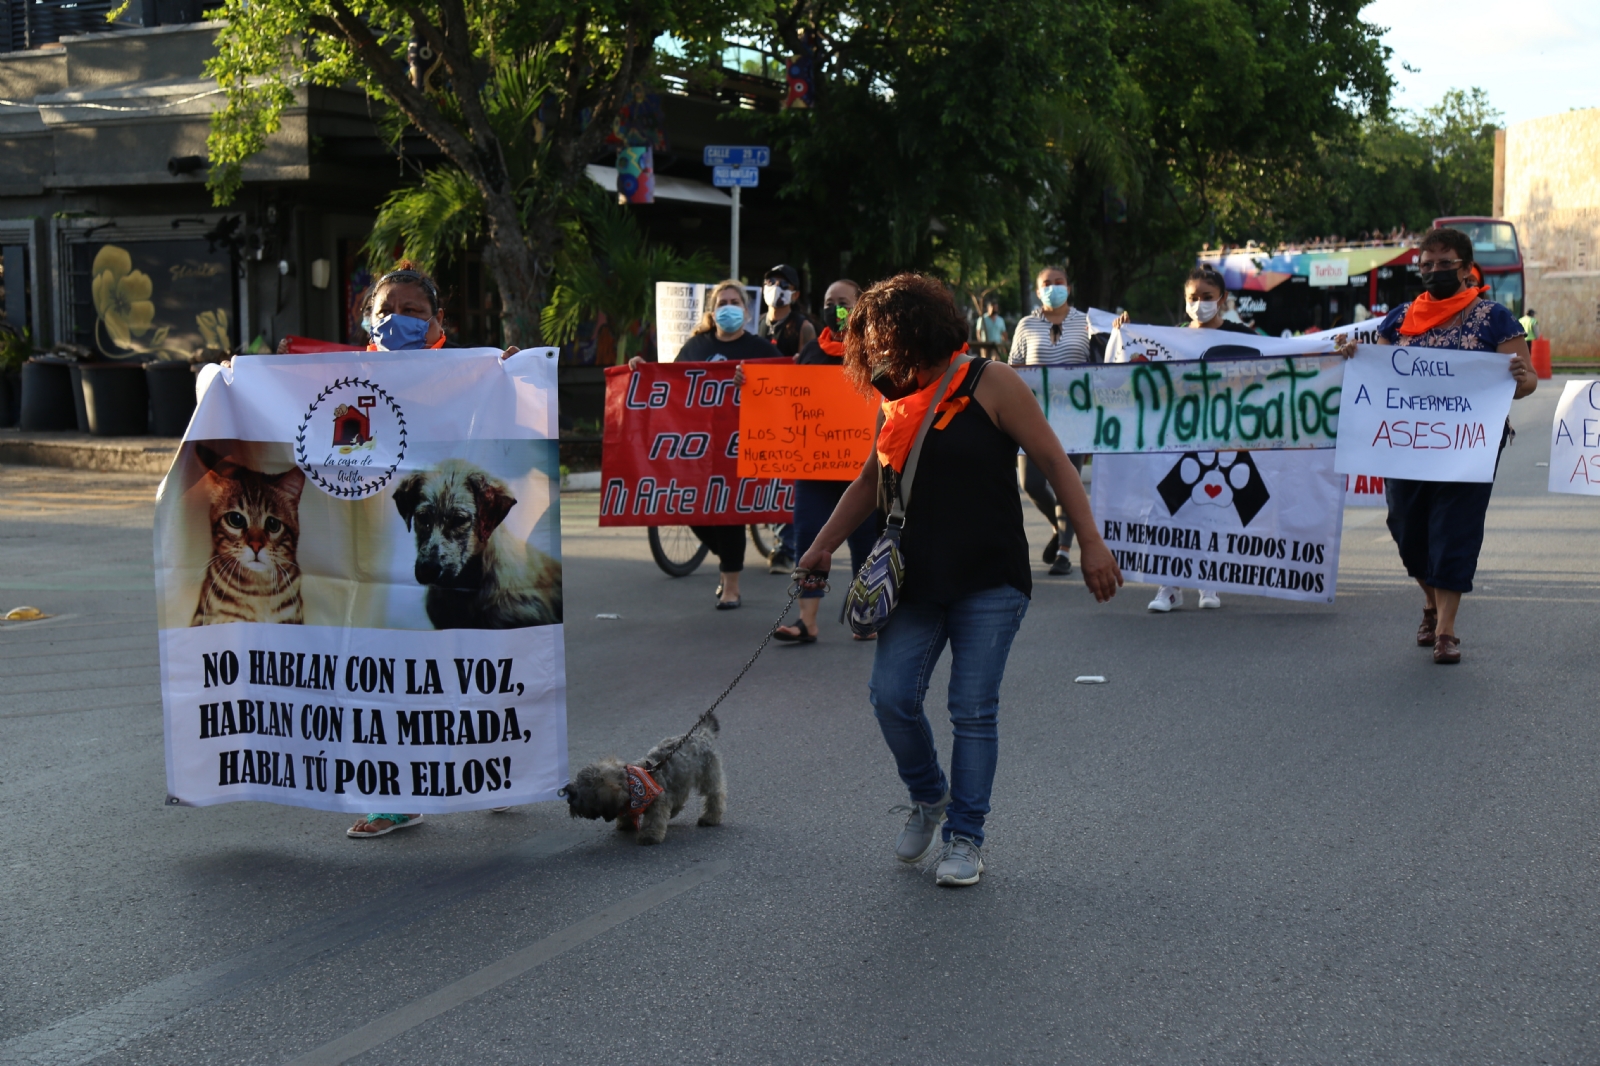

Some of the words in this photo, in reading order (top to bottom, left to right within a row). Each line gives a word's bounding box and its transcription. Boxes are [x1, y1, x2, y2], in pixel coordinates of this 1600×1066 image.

[666, 286, 694, 297] TURISTA
[626, 371, 671, 409] La
[1354, 384, 1372, 406] A
[649, 432, 710, 460] no
[747, 428, 776, 441] LOS
[781, 424, 807, 448] 34
[1372, 420, 1486, 450] ASESINA
[1556, 418, 1574, 446] A
[744, 448, 803, 462] MUERTOS
[813, 450, 830, 460] EN
[837, 448, 851, 459] LA
[750, 462, 797, 476] JESUS
[632, 476, 697, 515] Arte
[1103, 520, 1121, 541] EN
[1126, 522, 1201, 550] MEMORIA
[1207, 531, 1219, 552] A
[1226, 533, 1287, 560] TODOS
[1291, 540, 1325, 565] LOS
[1110, 549, 1193, 579] NIMALITOS
[1198, 559, 1325, 593] SACRIFICADOS
[203, 650, 239, 688] NO
[249, 650, 338, 690] HABLAN
[345, 656, 396, 694] CON
[405, 659, 444, 695] LA
[454, 658, 525, 696] VOZ,
[199, 699, 294, 739] HABLAN
[301, 704, 344, 742] CON
[352, 708, 387, 745] LA
[396, 707, 532, 746] MIRADA,
[219, 749, 296, 788] HABLA
[303, 750, 327, 792] TÚ
[335, 759, 401, 795] POR
[410, 756, 512, 797] ELLOS!
